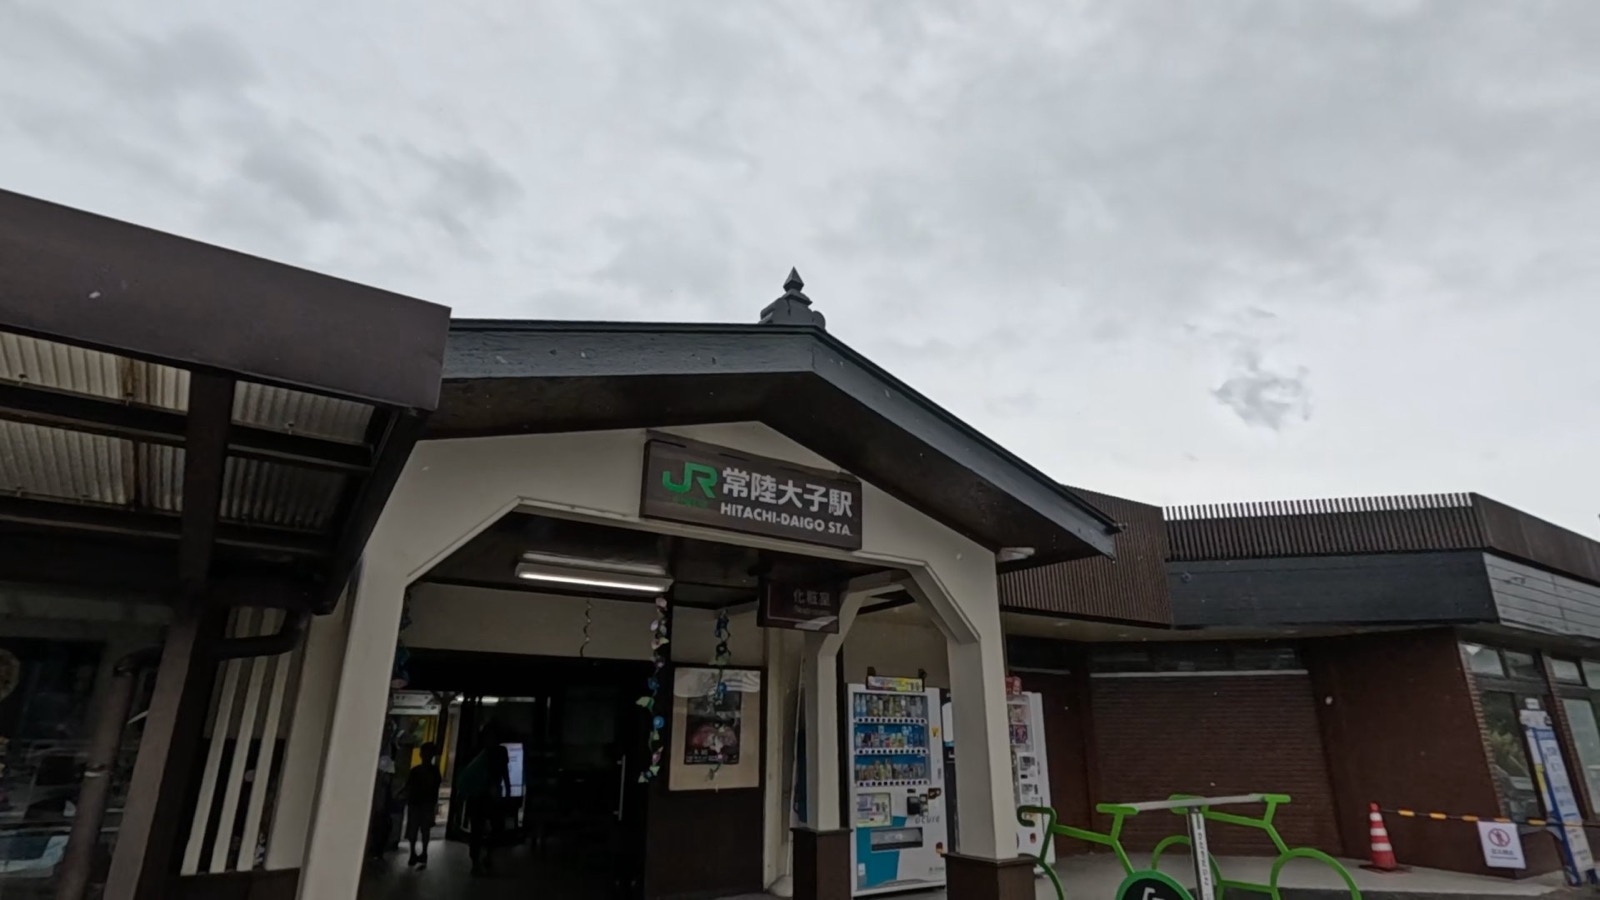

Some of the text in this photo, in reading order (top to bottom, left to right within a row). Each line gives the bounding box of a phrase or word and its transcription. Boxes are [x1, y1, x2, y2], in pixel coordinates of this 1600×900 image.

[662, 461, 718, 498] JR
[722, 466, 853, 518] 常陸大子駅
[720, 502, 826, 532] HITACHI-DAIGO
